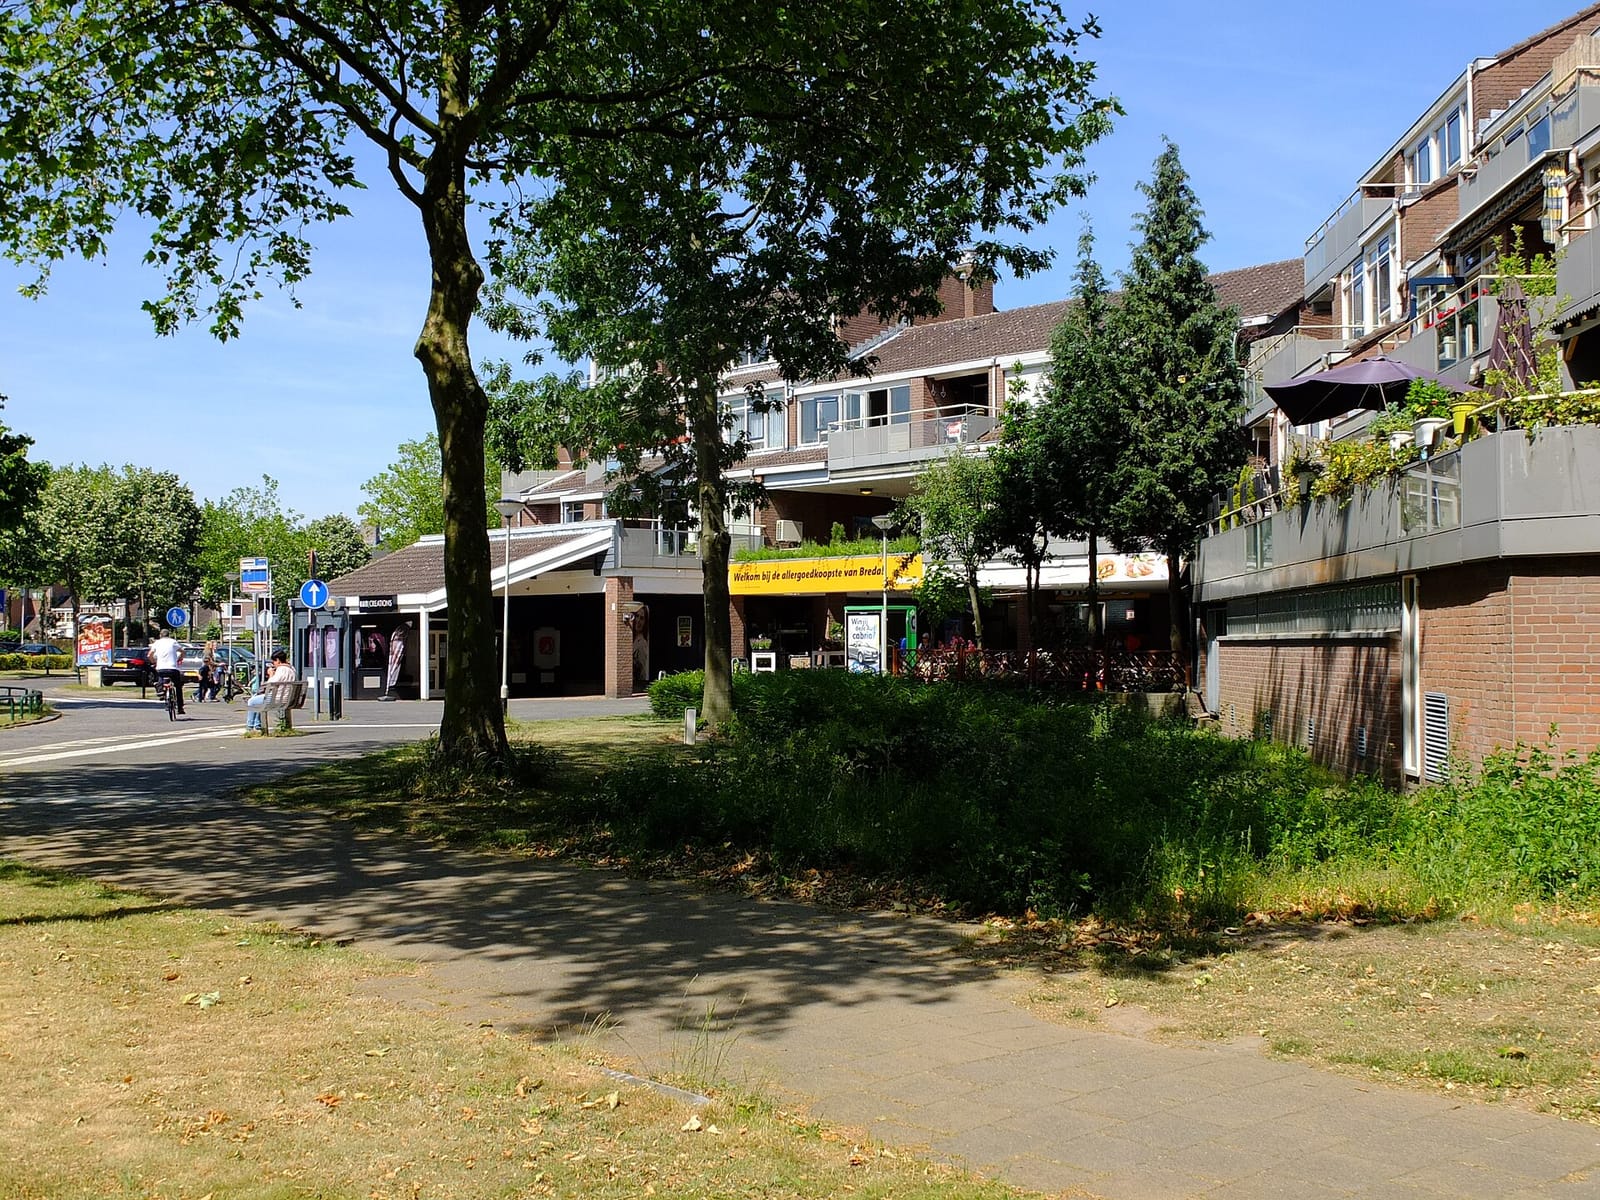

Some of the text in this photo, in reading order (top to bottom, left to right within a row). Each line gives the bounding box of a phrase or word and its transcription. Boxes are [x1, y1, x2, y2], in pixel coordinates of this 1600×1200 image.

[734, 570, 760, 582] Welkom
[762, 570, 771, 583] bij
[772, 570, 780, 580] de
[781, 566, 842, 582] allergoedkoopste
[844, 569, 858, 577] van
